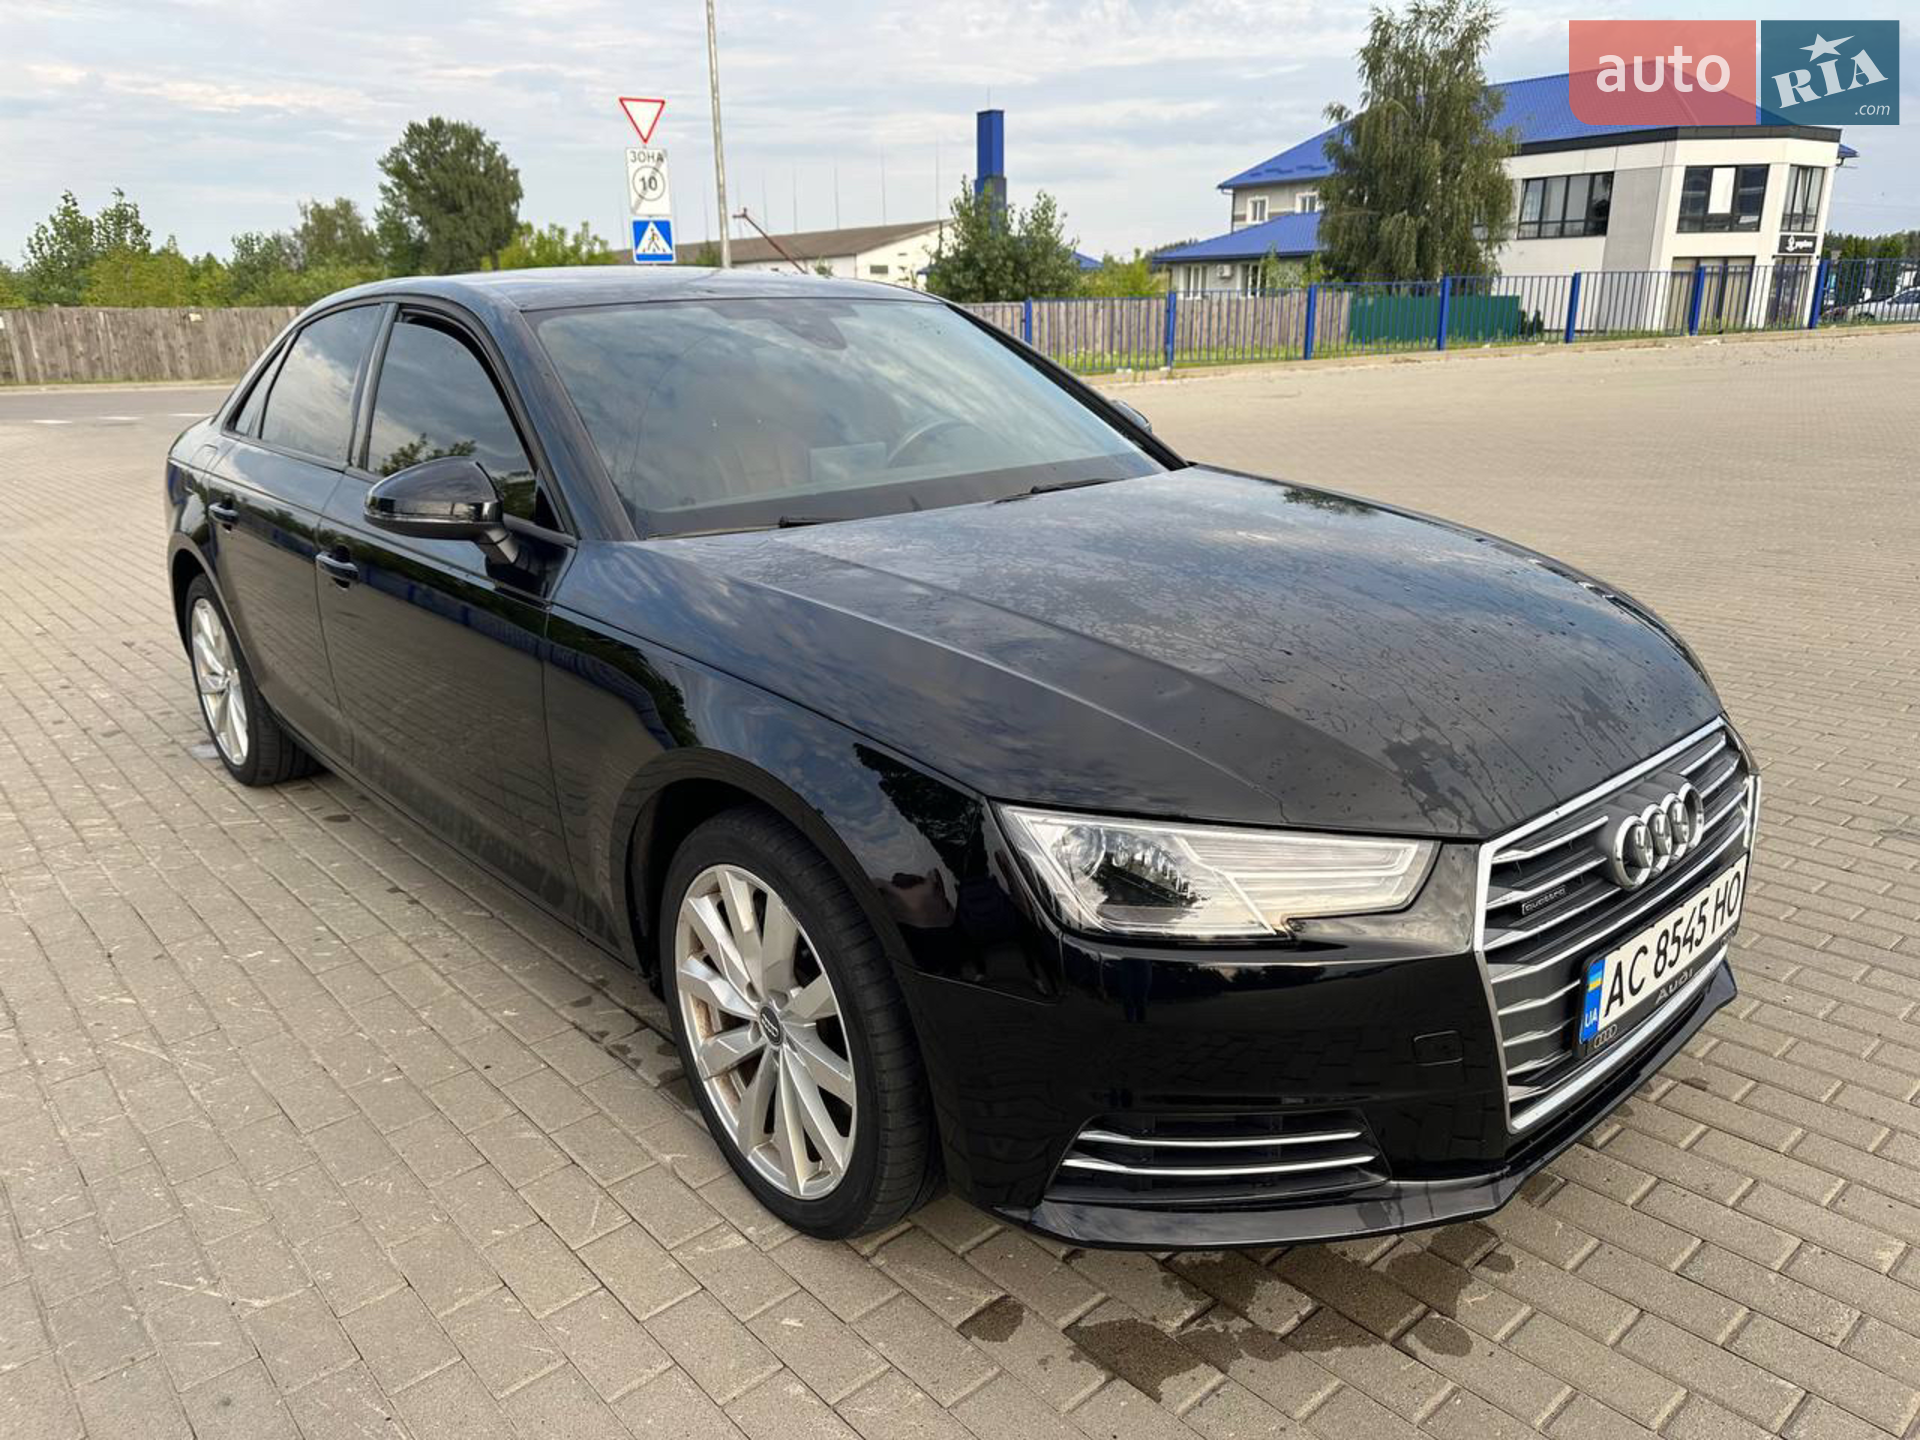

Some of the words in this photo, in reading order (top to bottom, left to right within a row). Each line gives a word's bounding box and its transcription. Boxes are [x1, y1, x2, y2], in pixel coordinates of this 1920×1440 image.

[630, 151, 664, 163] ЗОНА
[639, 175, 658, 191] 10
[1603, 945, 1648, 1018] AC
[1653, 896, 1709, 979] 8545
[1712, 871, 1741, 935] HO
[1655, 967, 1693, 1005] Audi
[1585, 1007, 1598, 1028] UA
